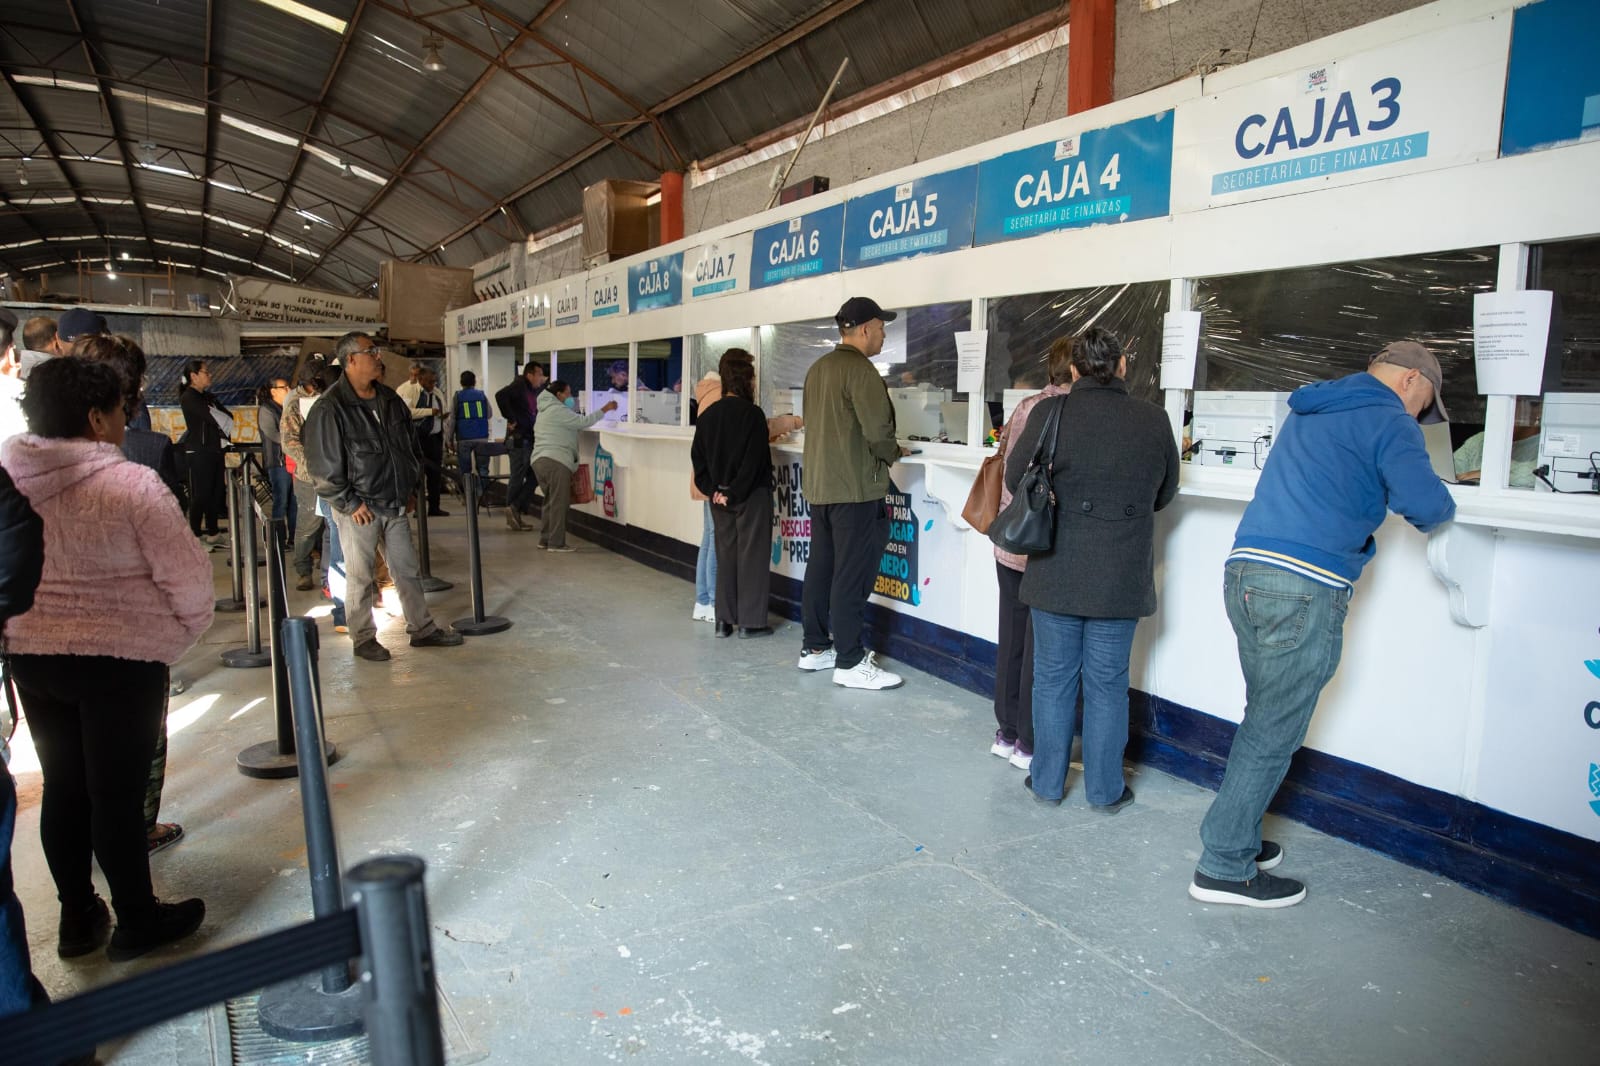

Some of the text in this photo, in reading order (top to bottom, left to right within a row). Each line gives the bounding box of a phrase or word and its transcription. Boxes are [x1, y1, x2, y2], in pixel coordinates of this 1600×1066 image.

[1234, 90, 1361, 160] CAJA
[1367, 77, 1402, 131] 3
[1221, 138, 1413, 191] SECRETARÍA DE FINANZAS
[1014, 153, 1121, 209] CAJA 4
[869, 192, 938, 240] CAJA 5
[1060, 209, 1070, 220] DE
[1074, 199, 1121, 218] FINANZAS
[769, 230, 820, 266] CAJA 6
[910, 230, 944, 248] FINANZAS
[696, 253, 736, 282] CAJA 7
[639, 272, 662, 296] CAJA
[663, 270, 670, 290] 8
[557, 298, 571, 314] CAJA
[571, 297, 578, 311] 10
[594, 285, 618, 306] CAJA 9
[467, 315, 480, 334] CAJAS
[480, 311, 507, 332] ESPECIALES
[528, 304, 540, 319] CAJA
[886, 494, 906, 506] EN UN
[893, 506, 912, 521] PARA
[781, 520, 812, 538] DESCUE
[790, 540, 810, 563] PRE
[898, 544, 906, 555] EN
[880, 553, 909, 579] NERO
[874, 575, 909, 600] EBRERO
